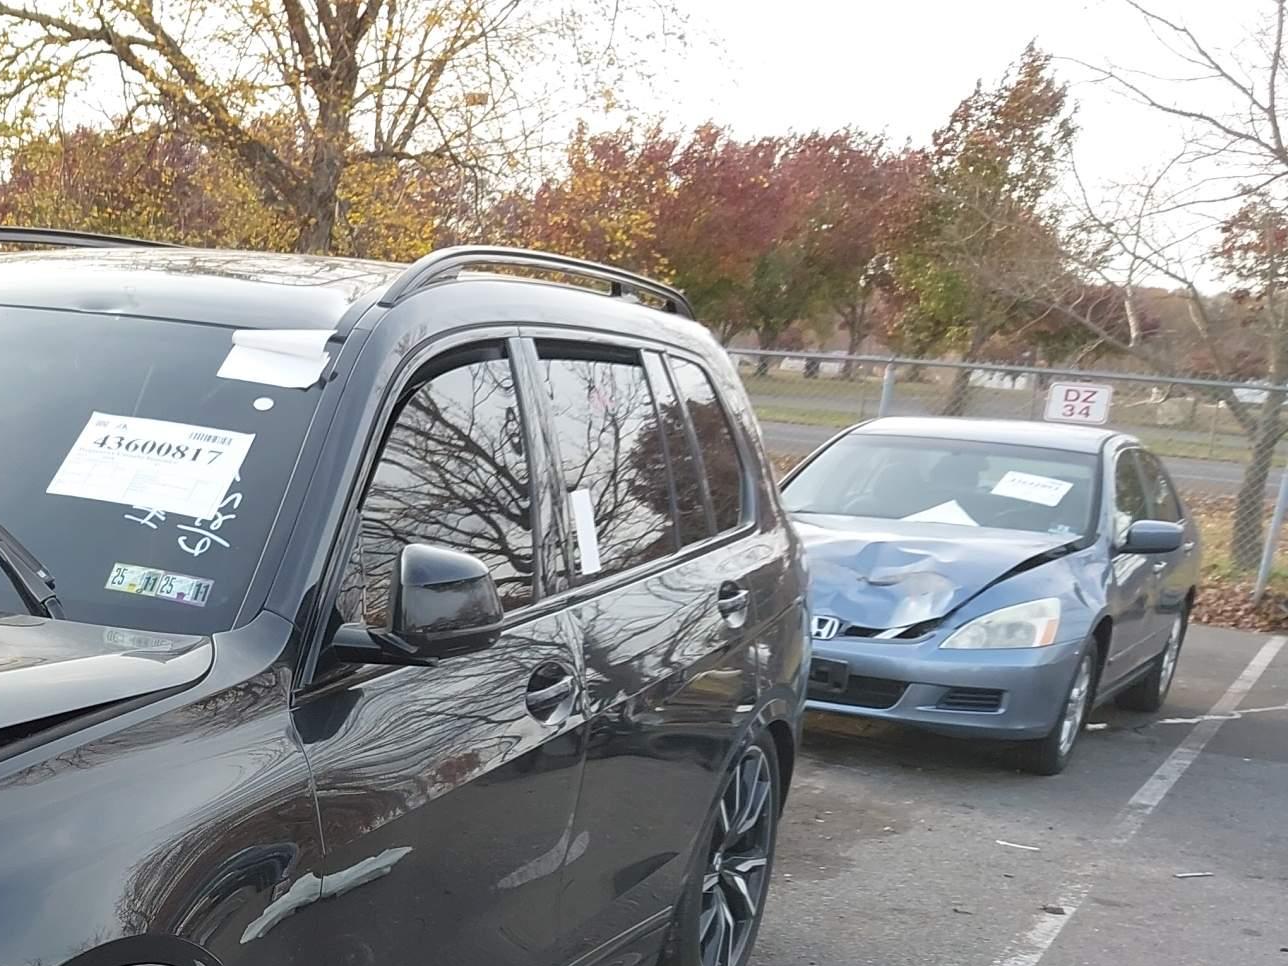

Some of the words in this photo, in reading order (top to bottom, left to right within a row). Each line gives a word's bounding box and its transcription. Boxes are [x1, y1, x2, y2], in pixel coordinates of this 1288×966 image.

[1064, 388, 1098, 404] DZ
[1062, 404, 1091, 418] 34
[93, 434, 224, 465] 43600817
[111, 567, 129, 586] 25
[159, 575, 177, 595] 25
